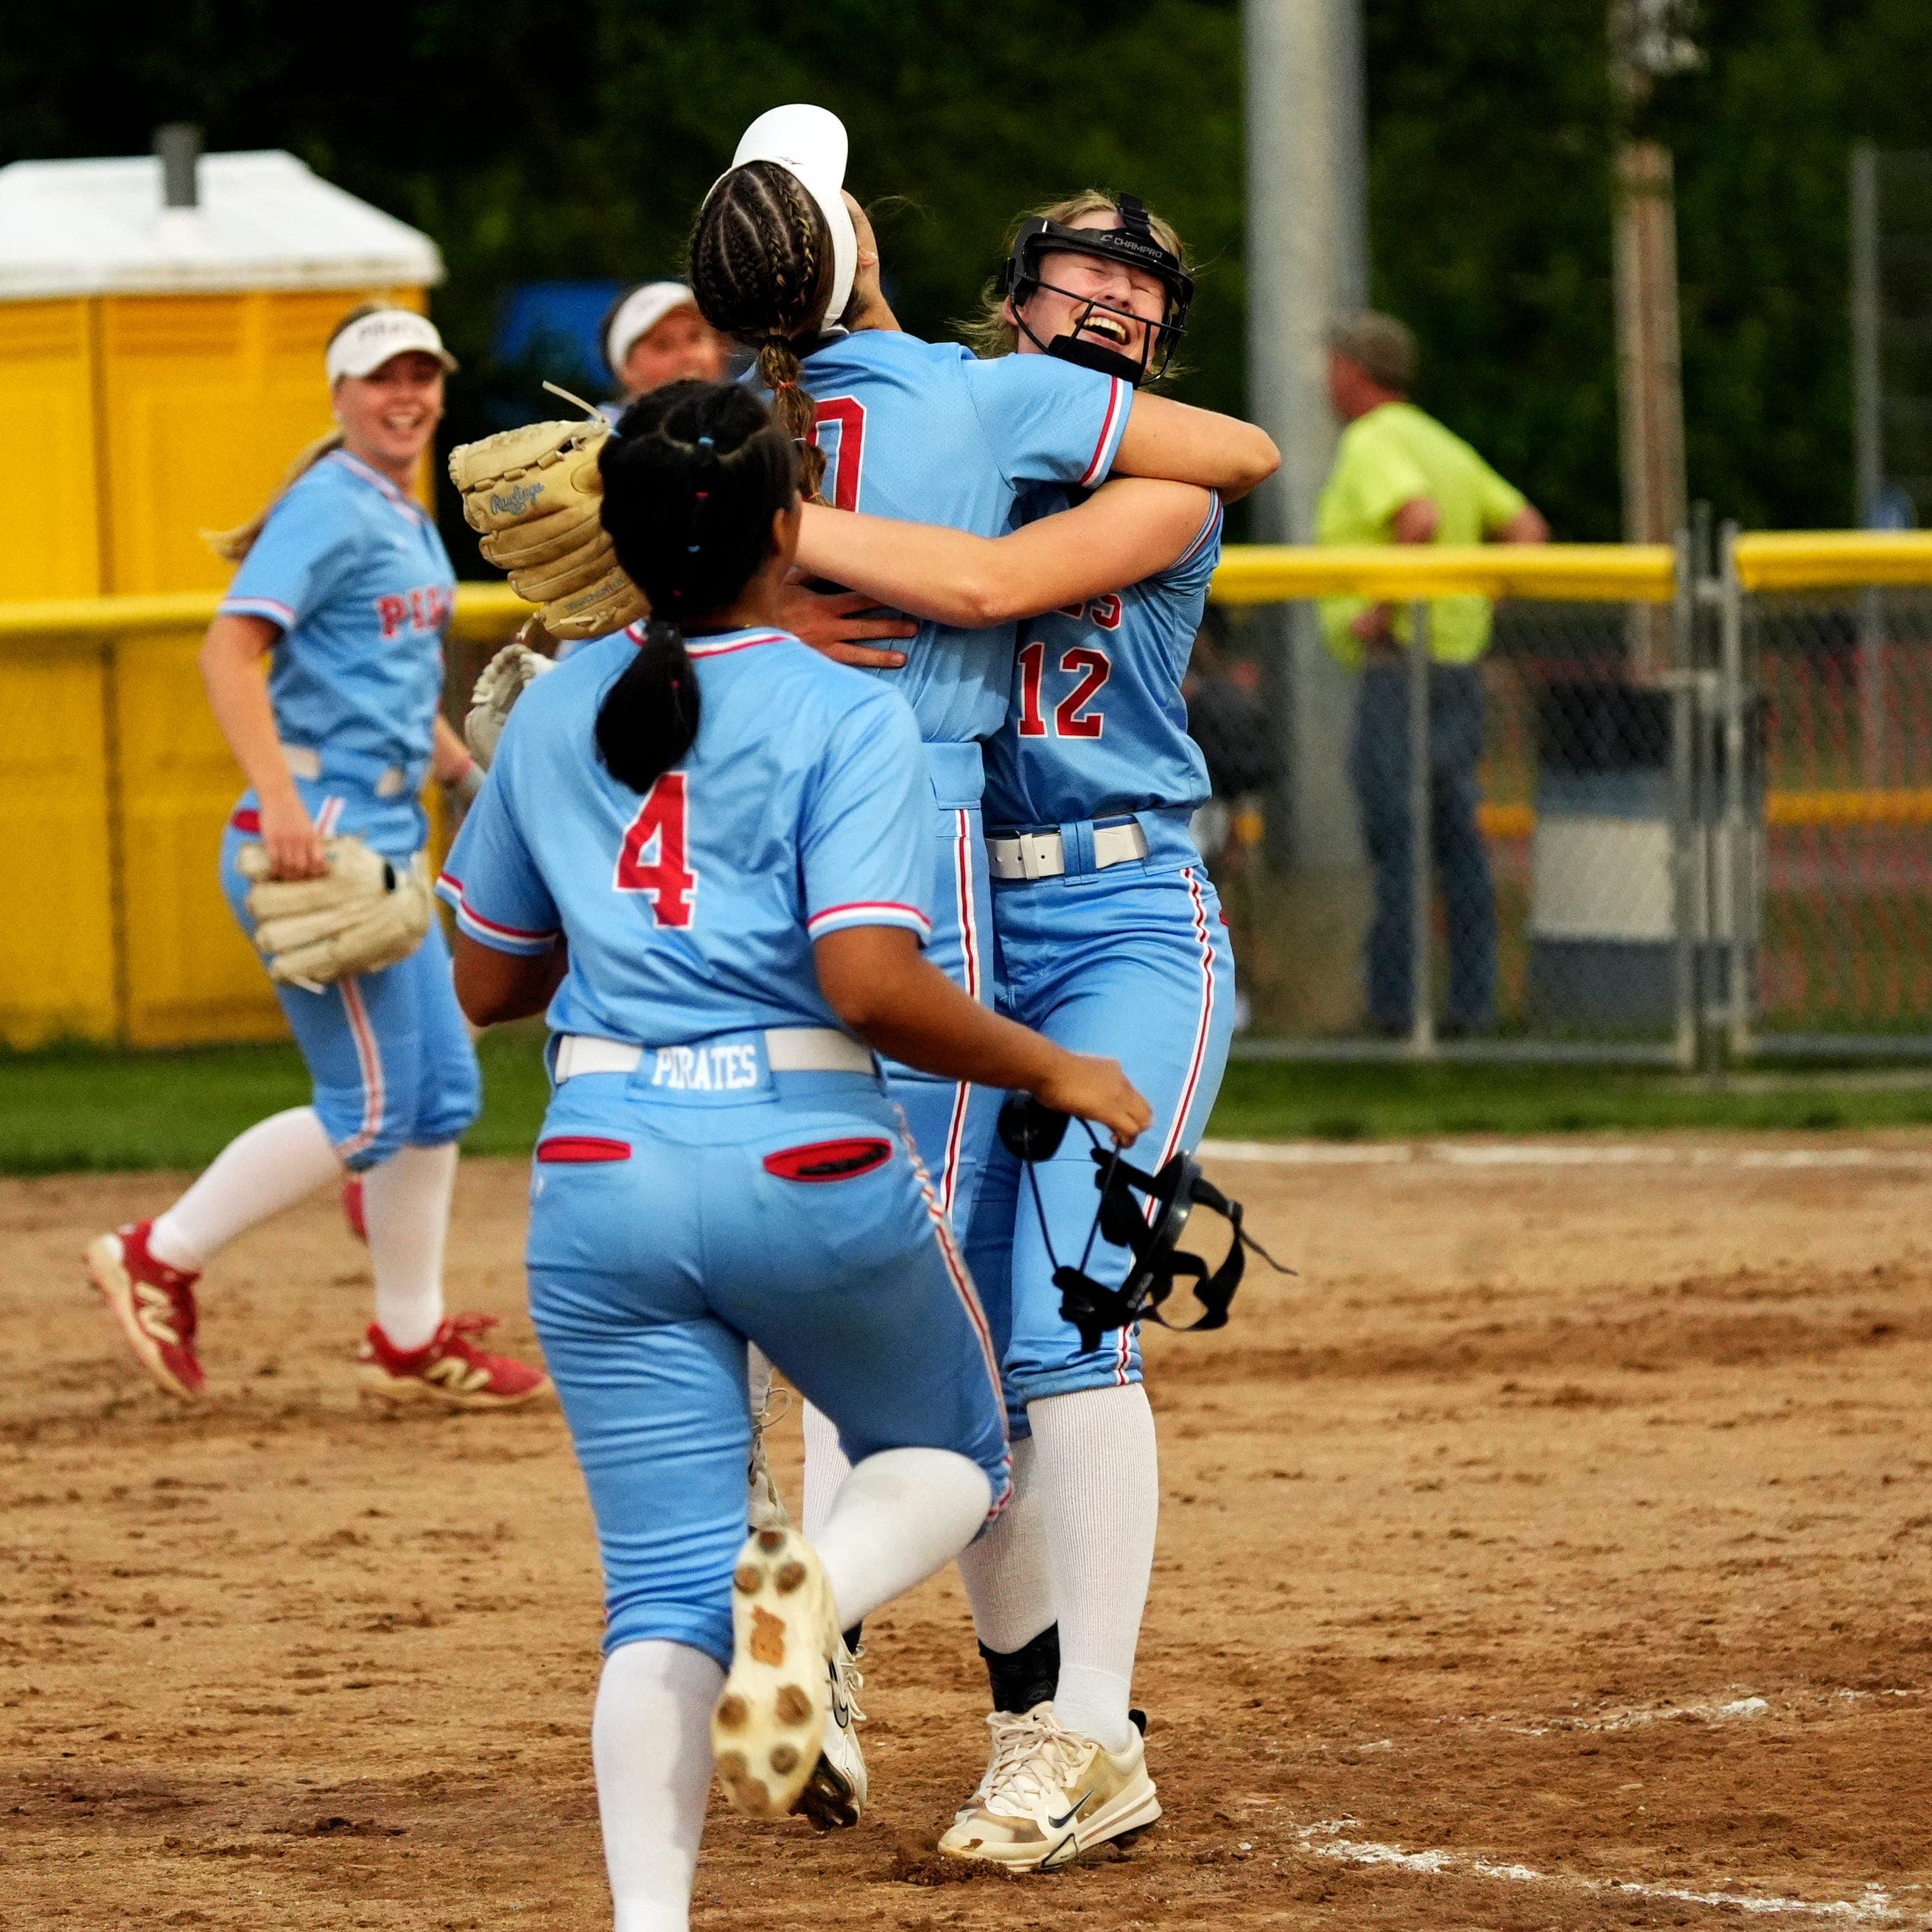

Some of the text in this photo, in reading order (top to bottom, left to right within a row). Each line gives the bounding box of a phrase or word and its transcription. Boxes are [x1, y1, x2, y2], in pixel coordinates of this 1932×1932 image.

[1113, 237, 1163, 258] CHAMPRO
[1018, 641, 1112, 739] 12
[612, 771, 699, 931] 4
[651, 1045, 757, 1090] PIRATES
